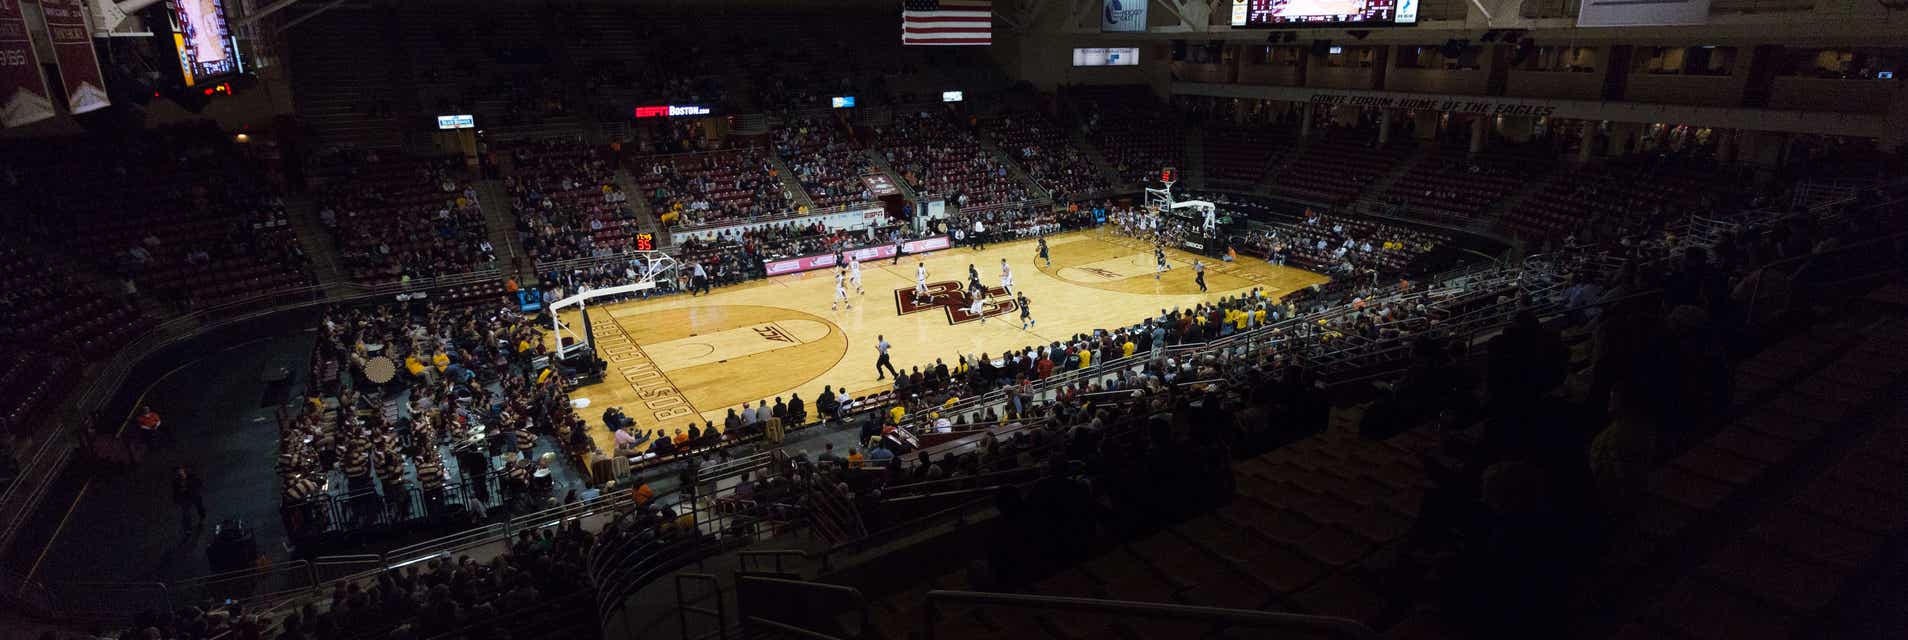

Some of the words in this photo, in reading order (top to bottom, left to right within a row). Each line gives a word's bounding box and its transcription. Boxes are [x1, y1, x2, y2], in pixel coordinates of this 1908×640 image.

[1312, 95, 1344, 104] CONTE
[1350, 96, 1394, 105] FORUM
[1399, 98, 1440, 108] HOME
[1441, 101, 1464, 110] OF
[1464, 101, 1492, 112] THE
[1495, 103, 1557, 113] EAGLES
[864, 210, 883, 219] ESPN
[638, 239, 652, 250] 35
[617, 362, 695, 422] BOSTON
